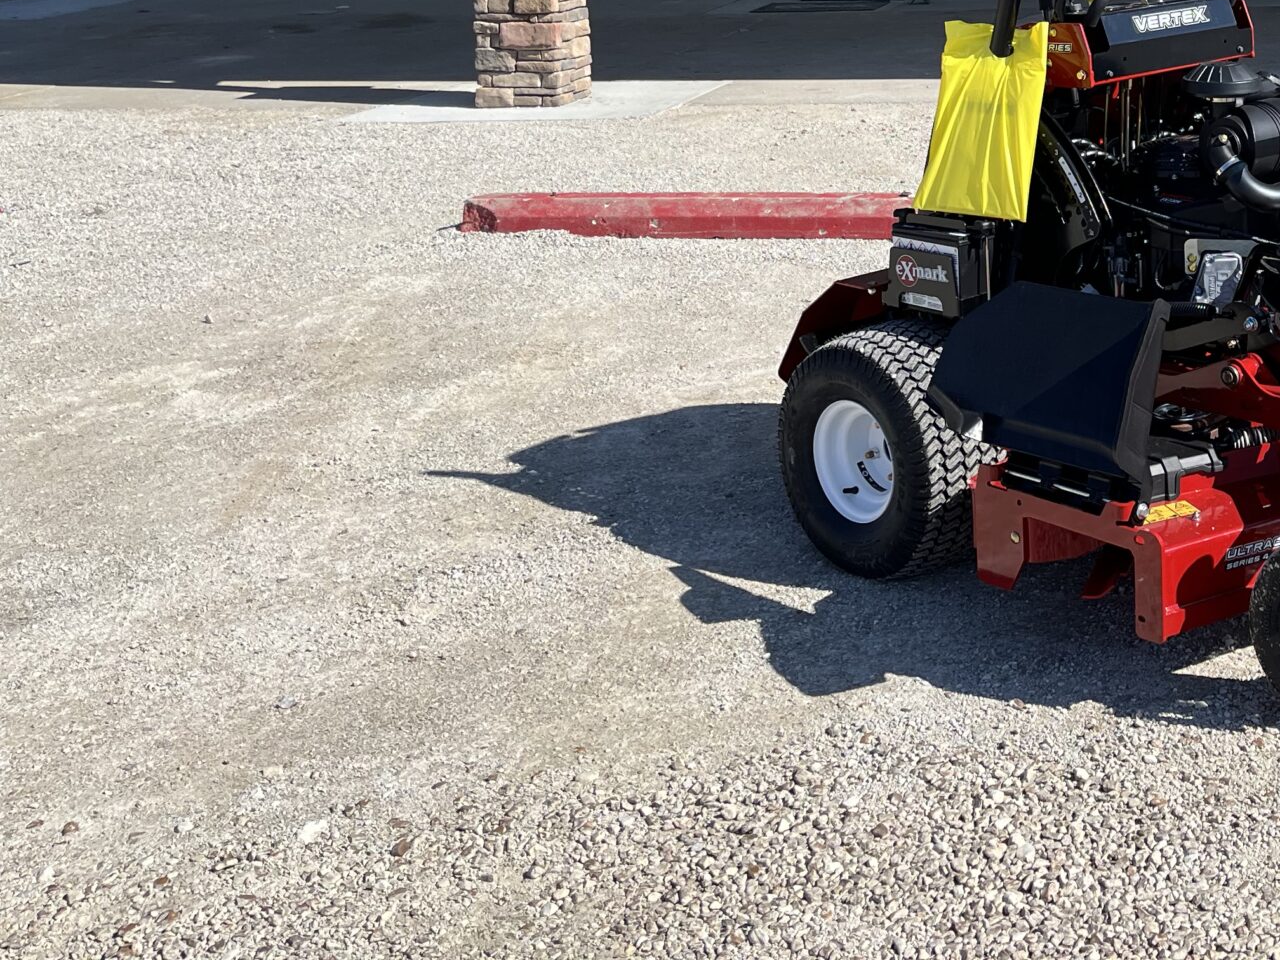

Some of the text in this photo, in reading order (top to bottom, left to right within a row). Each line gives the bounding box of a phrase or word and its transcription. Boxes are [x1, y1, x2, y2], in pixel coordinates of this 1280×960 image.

[1132, 5, 1210, 33] VERTEX
[1048, 43, 1071, 52] RIES
[1226, 555, 1261, 570] SERIES
